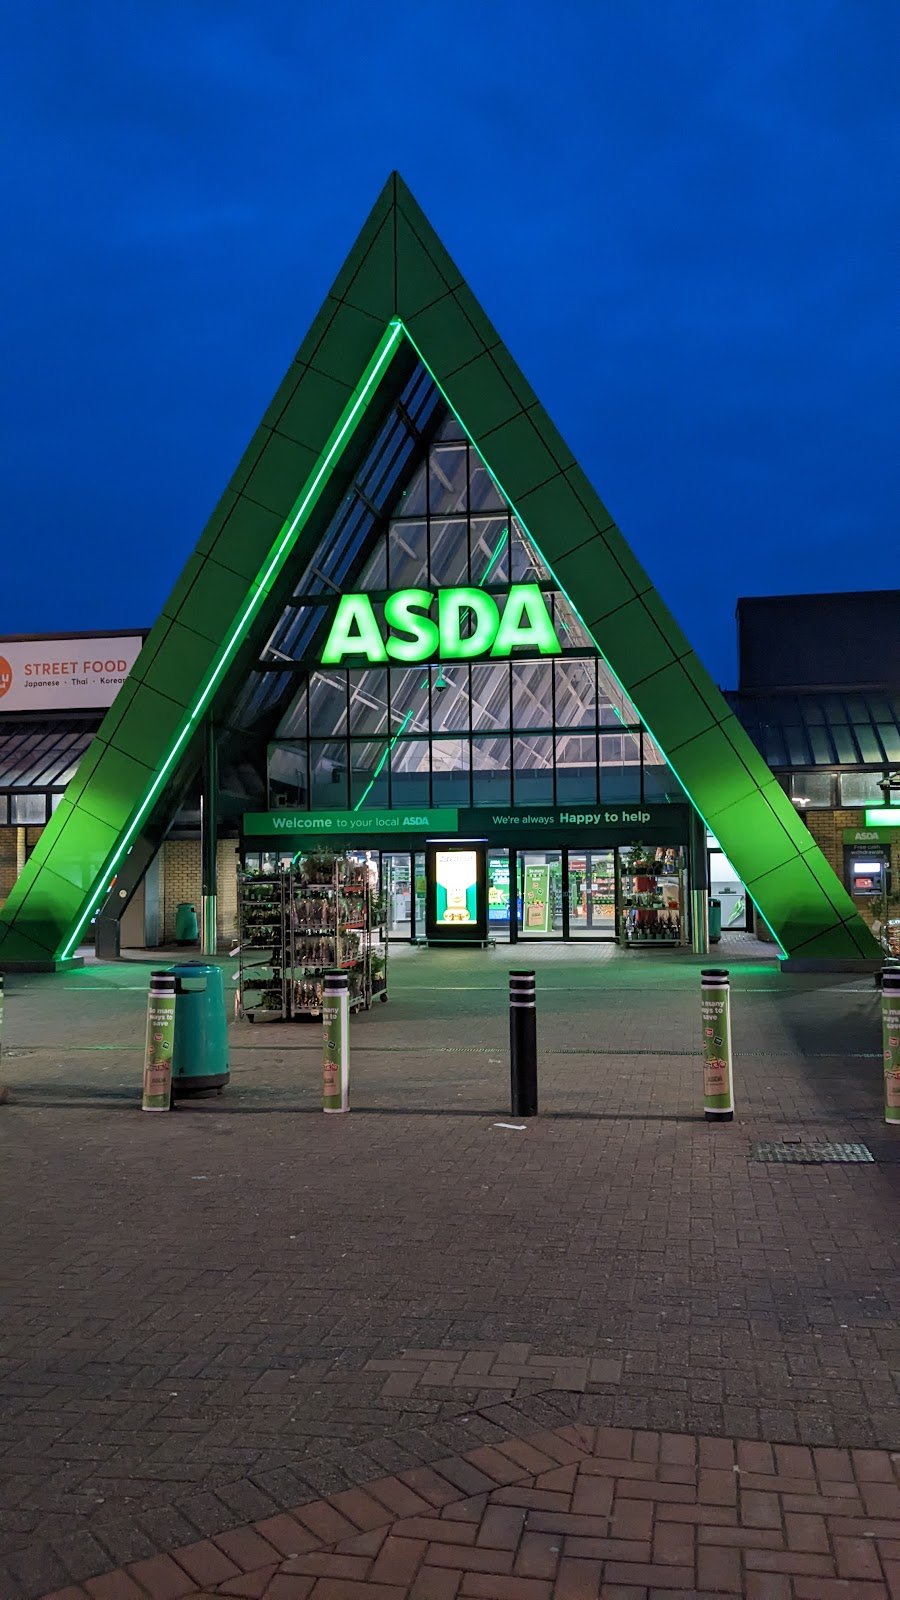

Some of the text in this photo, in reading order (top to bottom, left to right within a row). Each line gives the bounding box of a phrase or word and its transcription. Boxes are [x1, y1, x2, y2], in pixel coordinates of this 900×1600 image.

[321, 584, 562, 664] ASDA
[24, 660, 127, 676] STREET FOOD
[24, 680, 60, 688] Japanese
[71, 678, 88, 686] Thai
[272, 816, 429, 829] Welcome to your local ASDA
[492, 811, 651, 825] We're always Happy to help
[855, 832, 879, 840] ASDA
